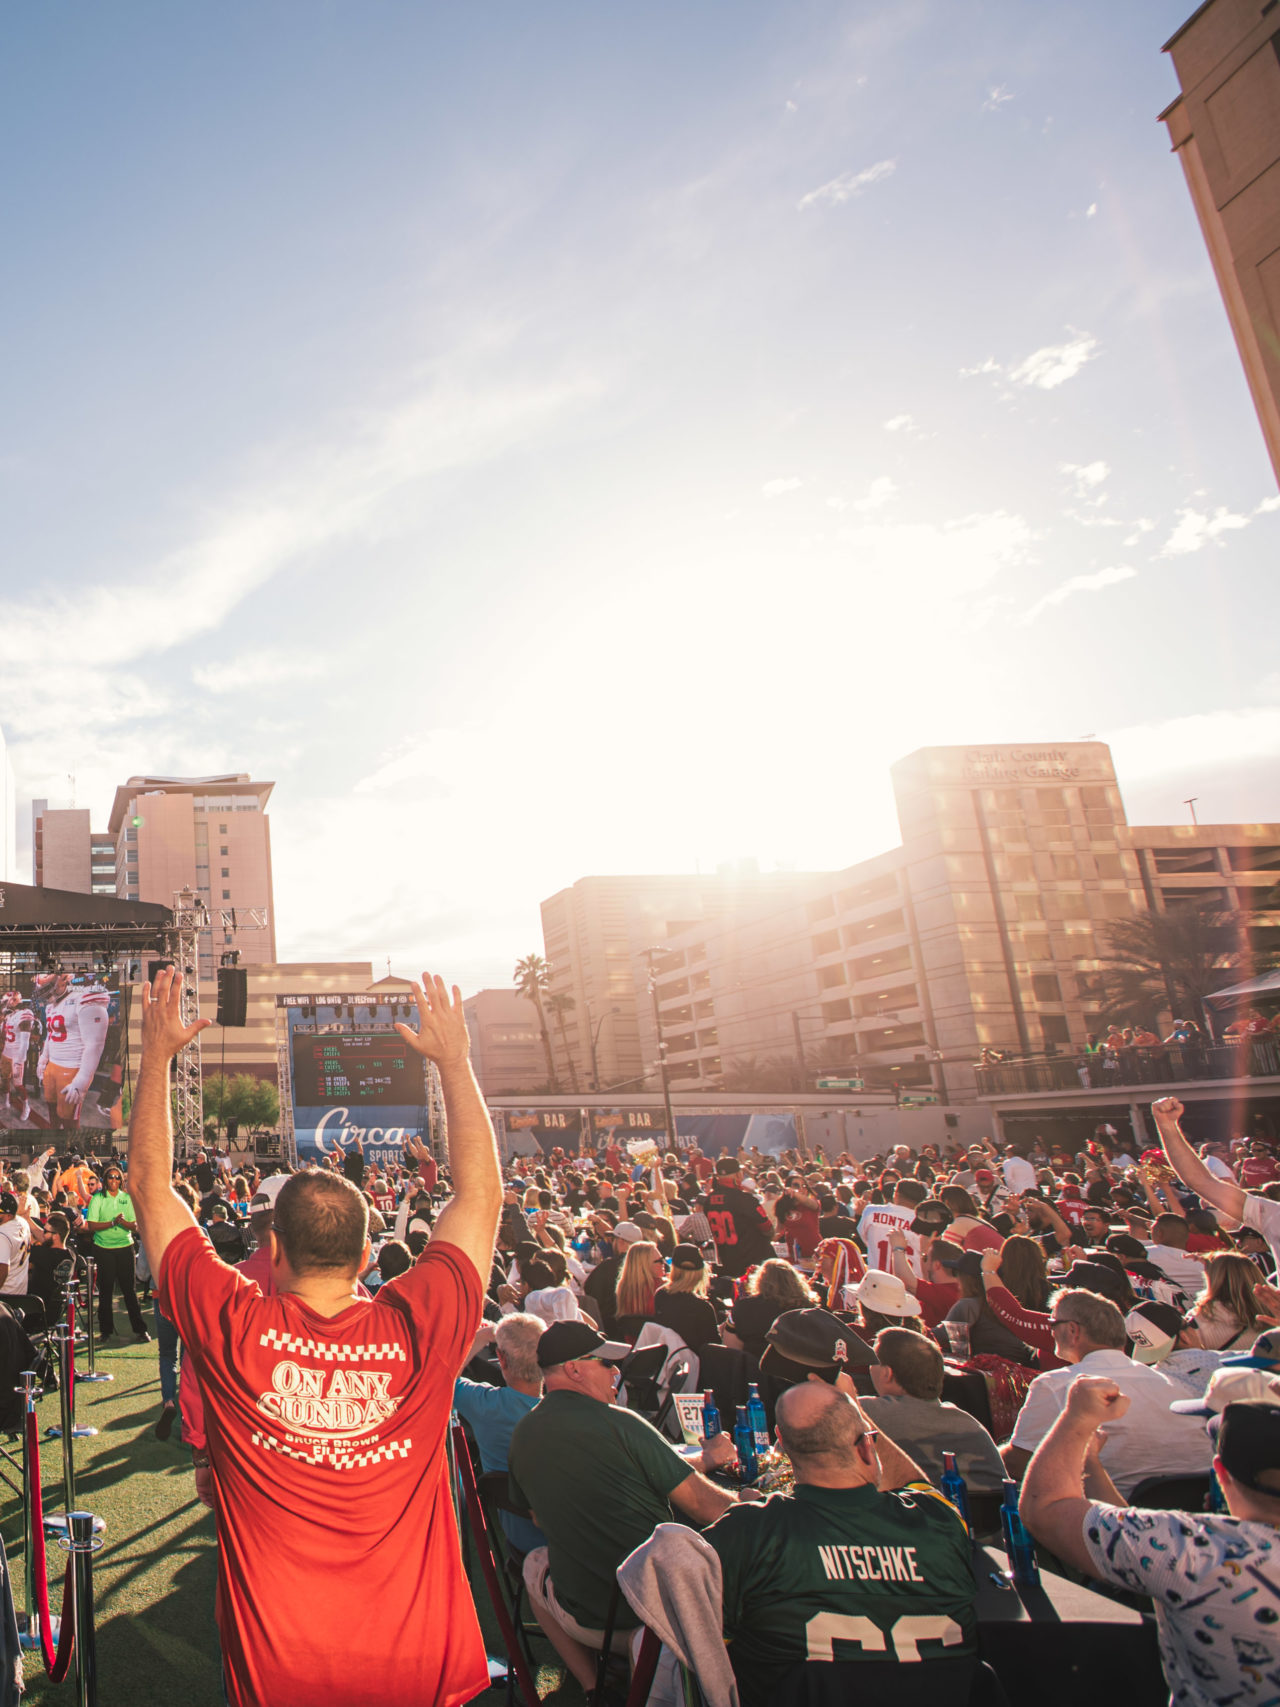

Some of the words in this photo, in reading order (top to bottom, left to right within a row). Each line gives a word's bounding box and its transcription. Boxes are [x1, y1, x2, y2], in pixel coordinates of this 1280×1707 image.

[1010, 749, 1067, 766] County
[1024, 764, 1081, 780] Garage
[543, 1113, 567, 1128] BAR
[628, 1112, 652, 1127] BAR
[314, 1107, 407, 1154] Circa
[369, 1149, 406, 1162] SPORTS
[872, 1212, 912, 1231] MONTA
[272, 1360, 326, 1398] ON
[327, 1369, 392, 1400] ANY
[256, 1392, 404, 1430] SUNDAY
[682, 1406, 704, 1421] 27
[285, 1432, 330, 1447] BRUCE
[334, 1434, 380, 1448] BROWN
[817, 1545, 925, 1582] NITSCHKE
